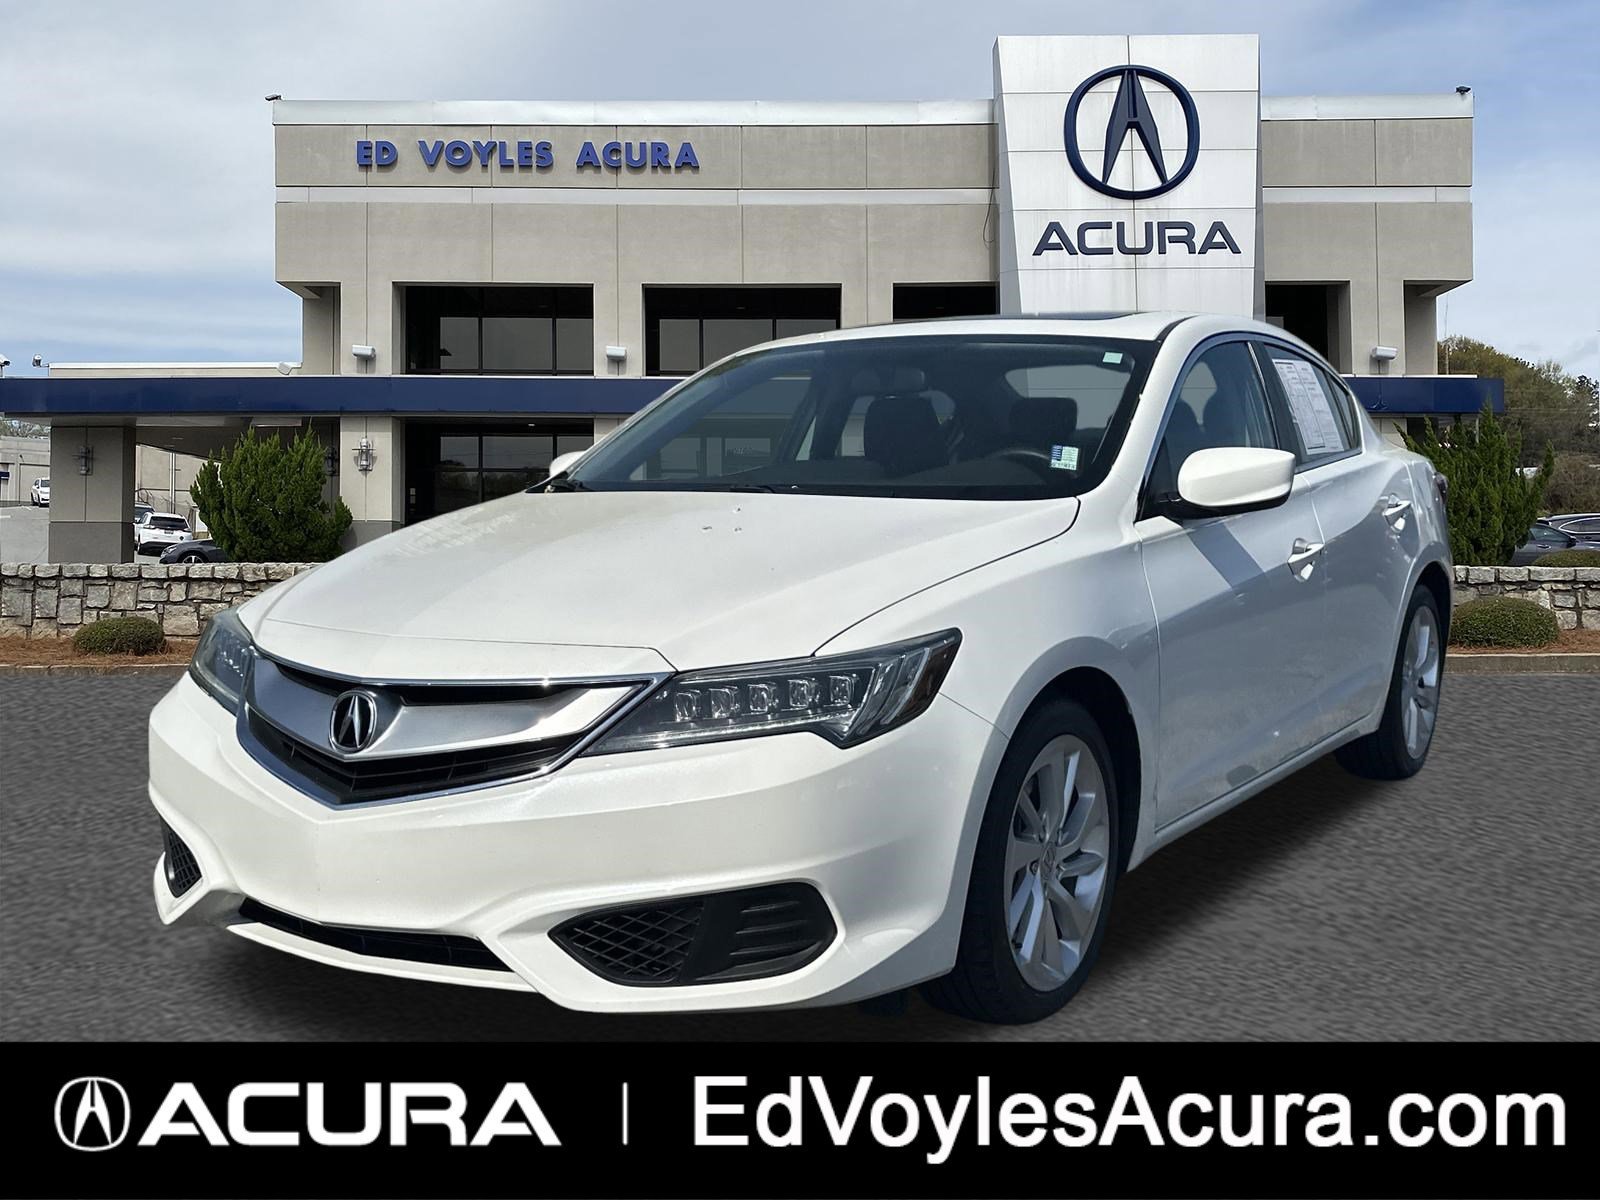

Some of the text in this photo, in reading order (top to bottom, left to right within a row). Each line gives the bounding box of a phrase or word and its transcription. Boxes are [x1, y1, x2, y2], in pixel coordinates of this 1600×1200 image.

[356, 139, 700, 168] ED VOYLES ACURA
[1032, 220, 1242, 256] ACURA
